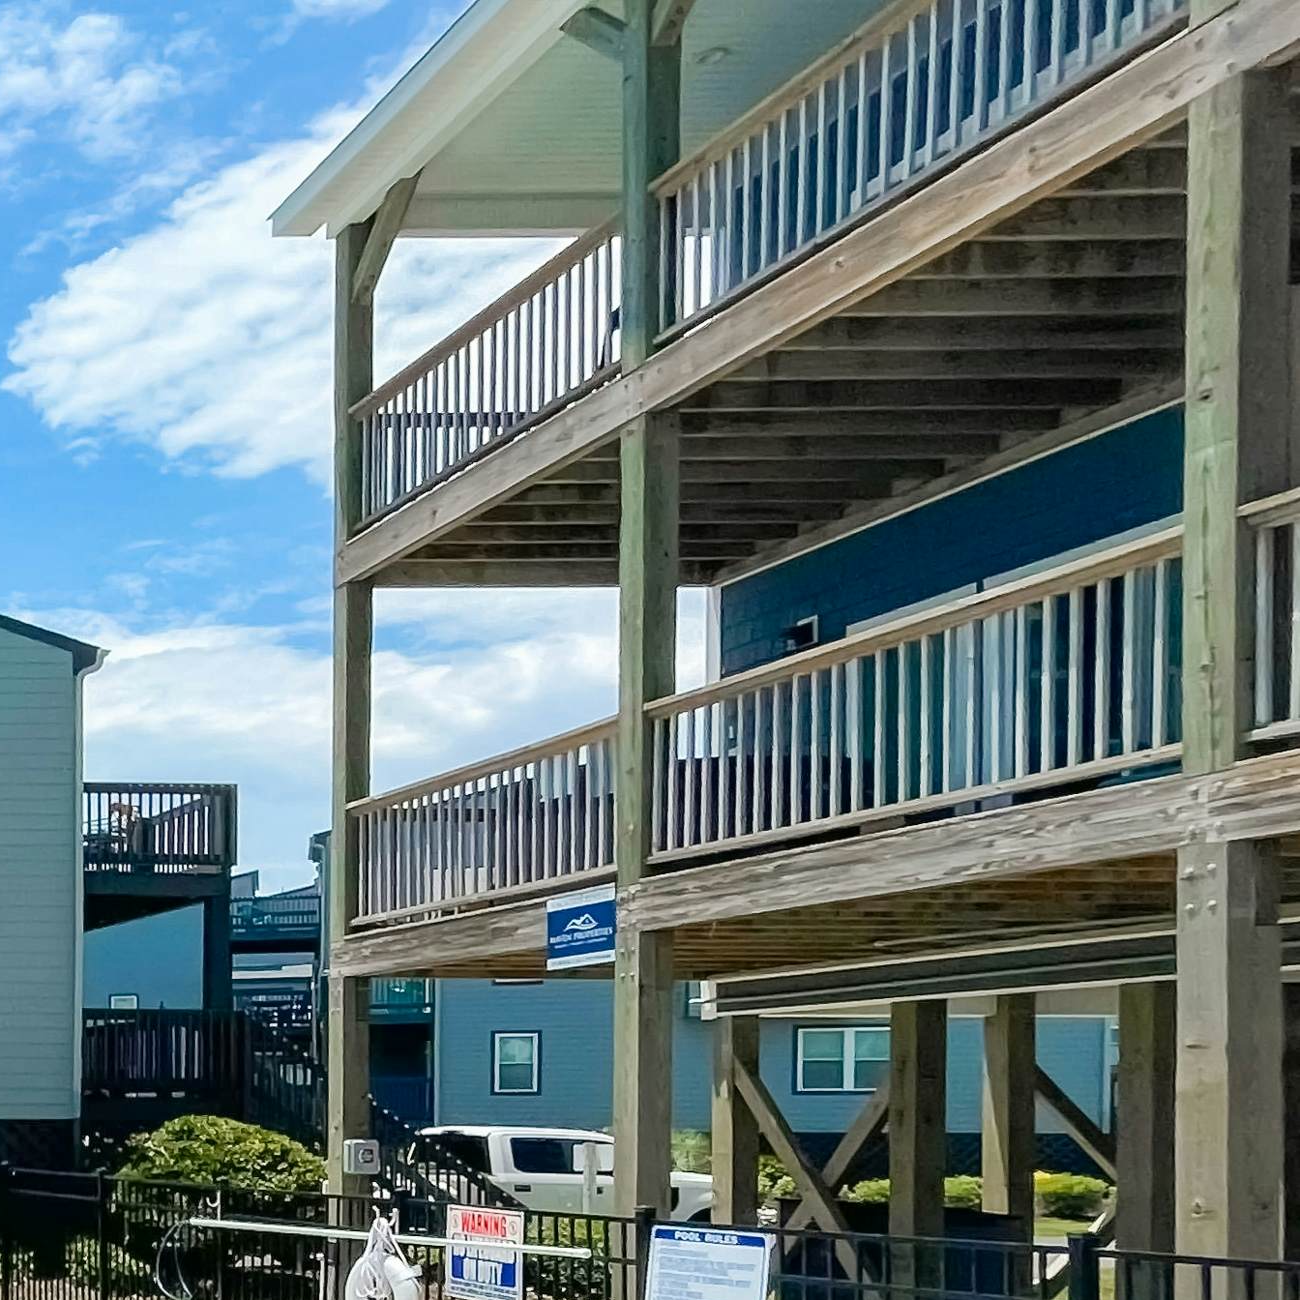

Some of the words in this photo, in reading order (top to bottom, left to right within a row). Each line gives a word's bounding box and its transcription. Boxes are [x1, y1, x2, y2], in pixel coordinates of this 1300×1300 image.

[461, 1212, 507, 1238] WARNING
[674, 1230, 701, 1242] POOL
[704, 1233, 738, 1245] RULES
